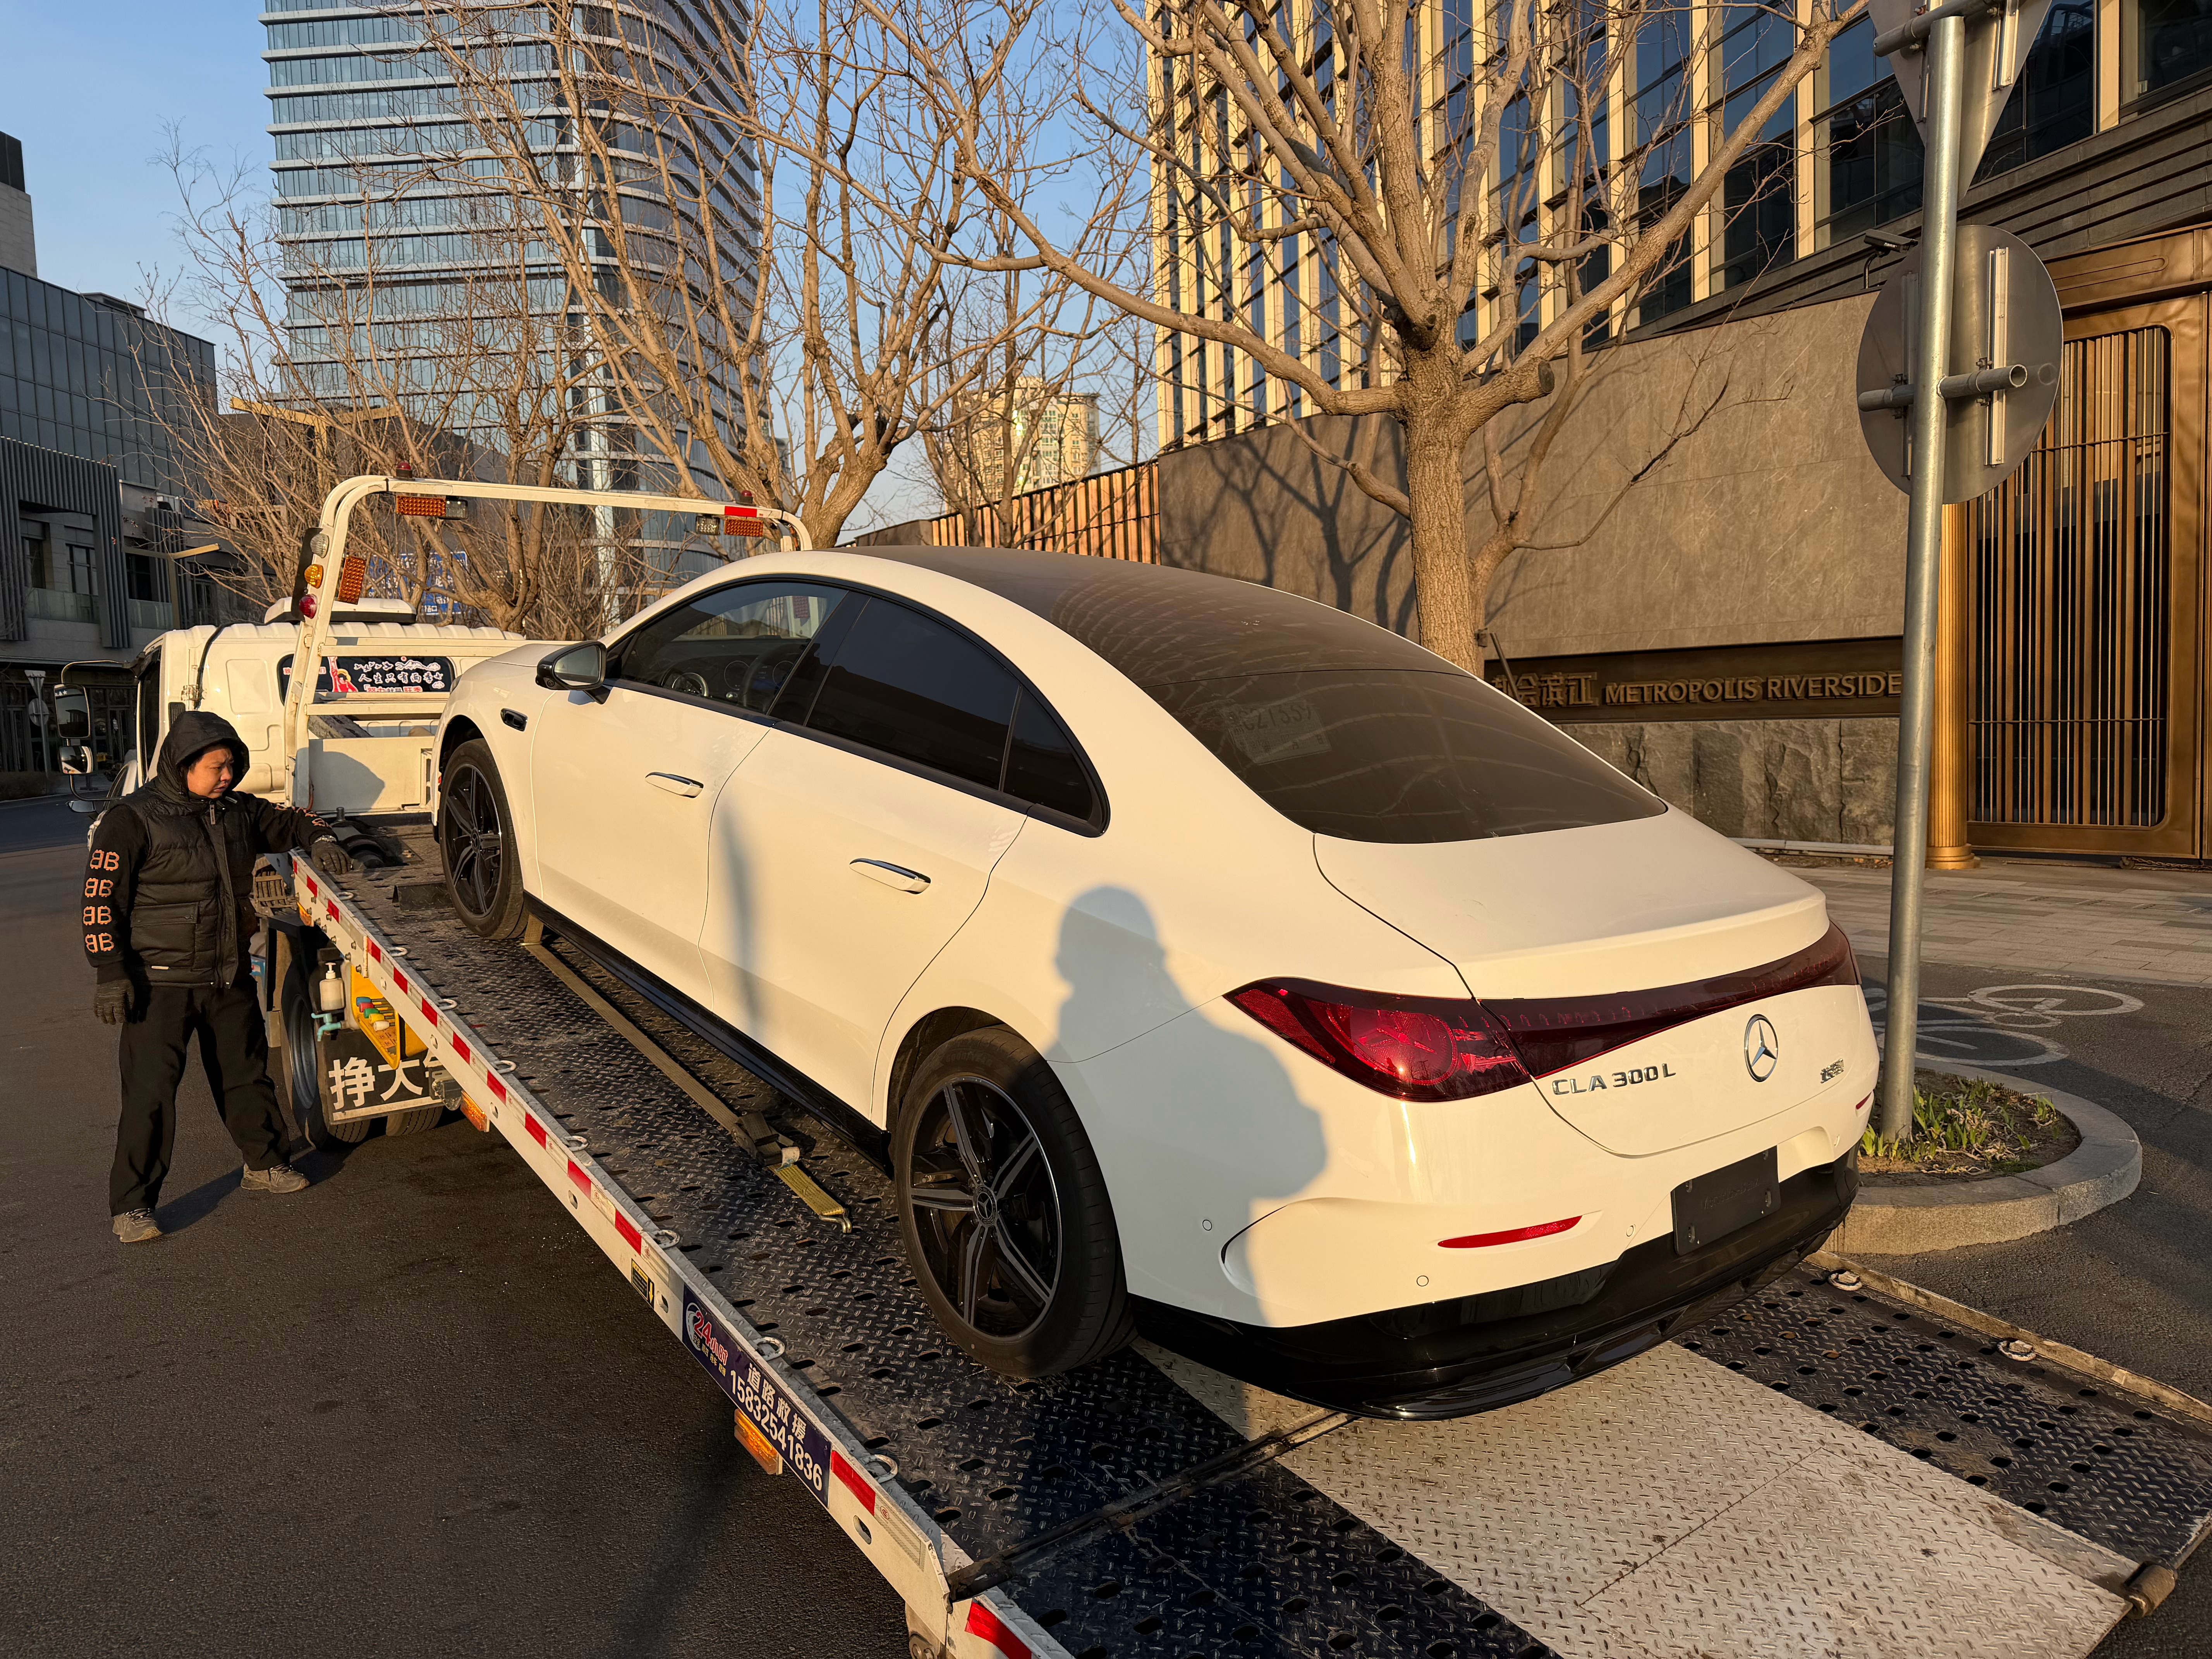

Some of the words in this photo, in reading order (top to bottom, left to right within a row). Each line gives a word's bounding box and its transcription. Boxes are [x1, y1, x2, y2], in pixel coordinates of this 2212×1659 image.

[359, 672, 433, 684] 人生只有两季
[1606, 679, 1759, 704] METROPOLIS
[1767, 673, 1902, 700] RIVERSIDE
[1552, 1074, 1607, 1096] CLA
[1612, 1065, 1658, 1088] 300
[1661, 1063, 1676, 1078] L
[693, 1311, 728, 1366] 24小时
[748, 1362, 807, 1444] 道路救援
[730, 1370, 823, 1492] 15832541836
